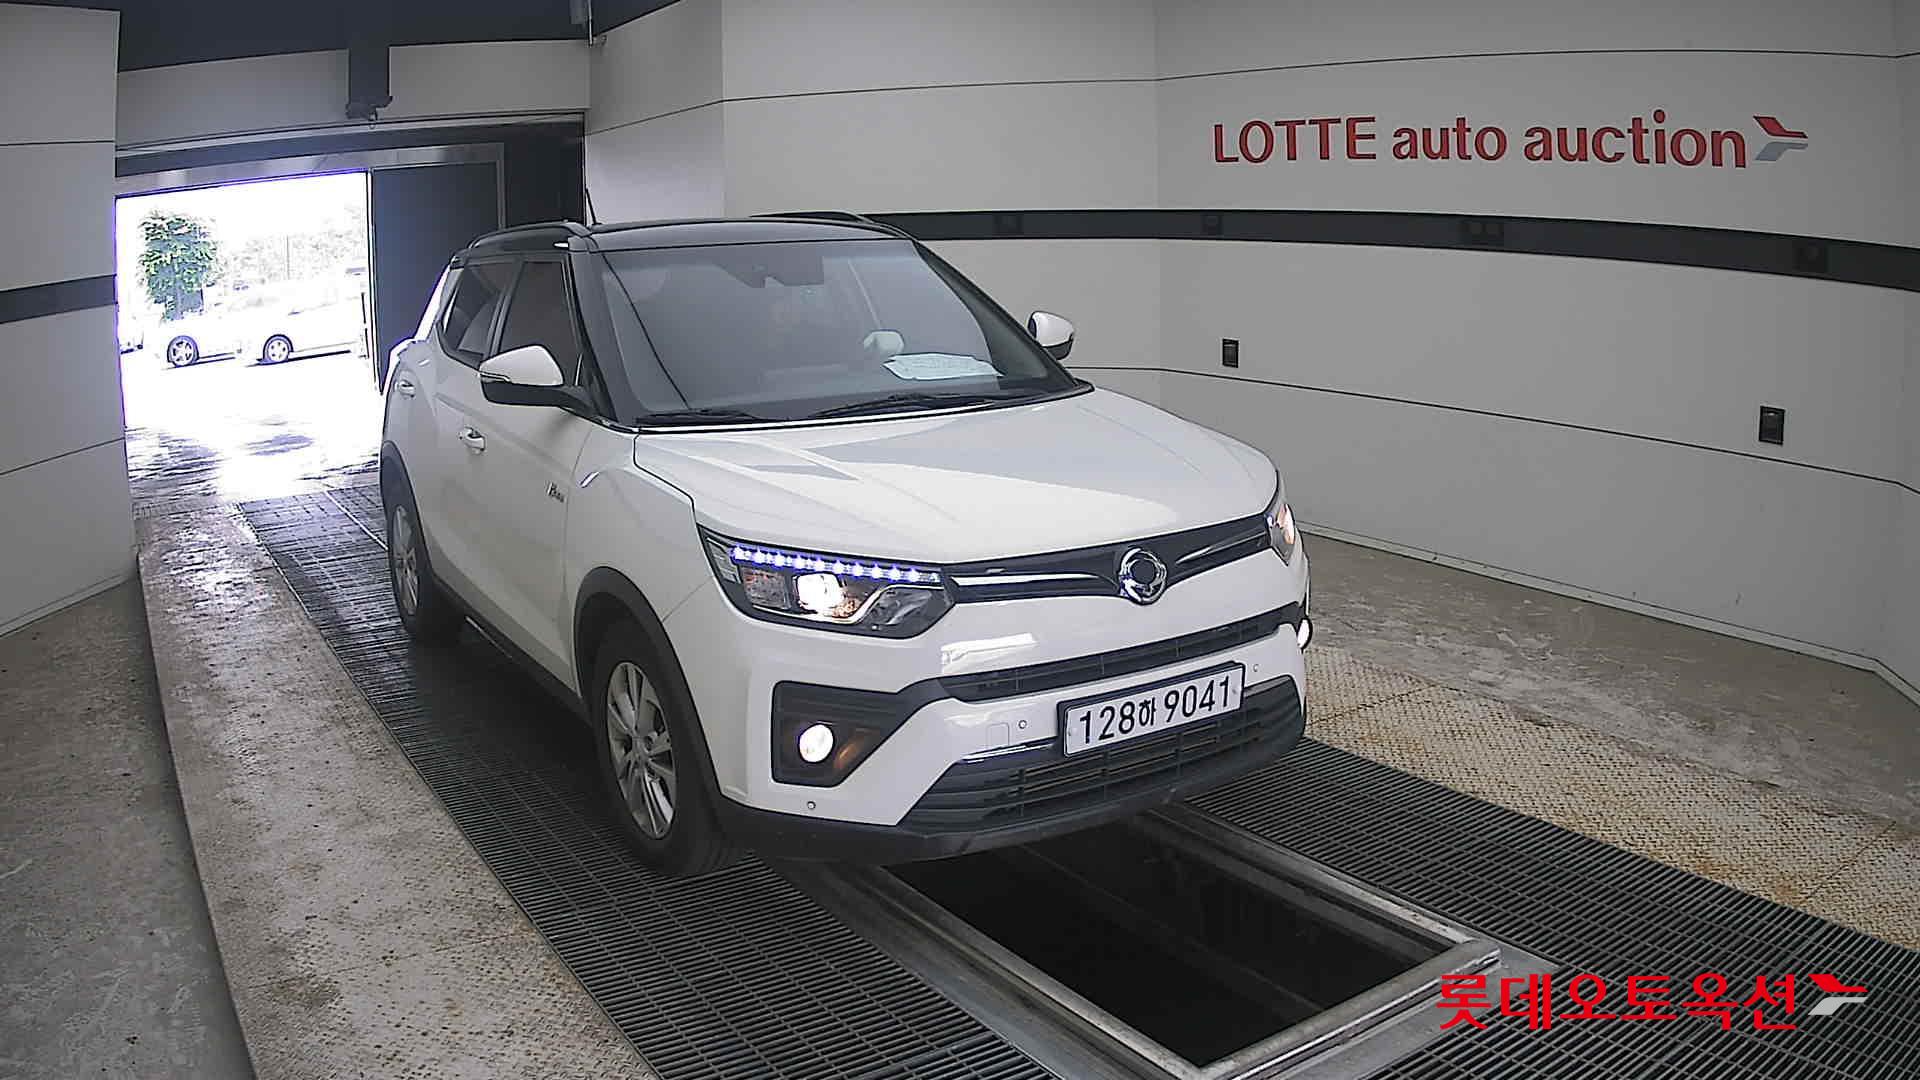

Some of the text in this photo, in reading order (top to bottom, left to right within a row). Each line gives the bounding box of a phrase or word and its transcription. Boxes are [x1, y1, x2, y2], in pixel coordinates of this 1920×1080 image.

[1213, 110, 1747, 168] LOTTE auto auction
[1079, 675, 1230, 745] 128하 9041
